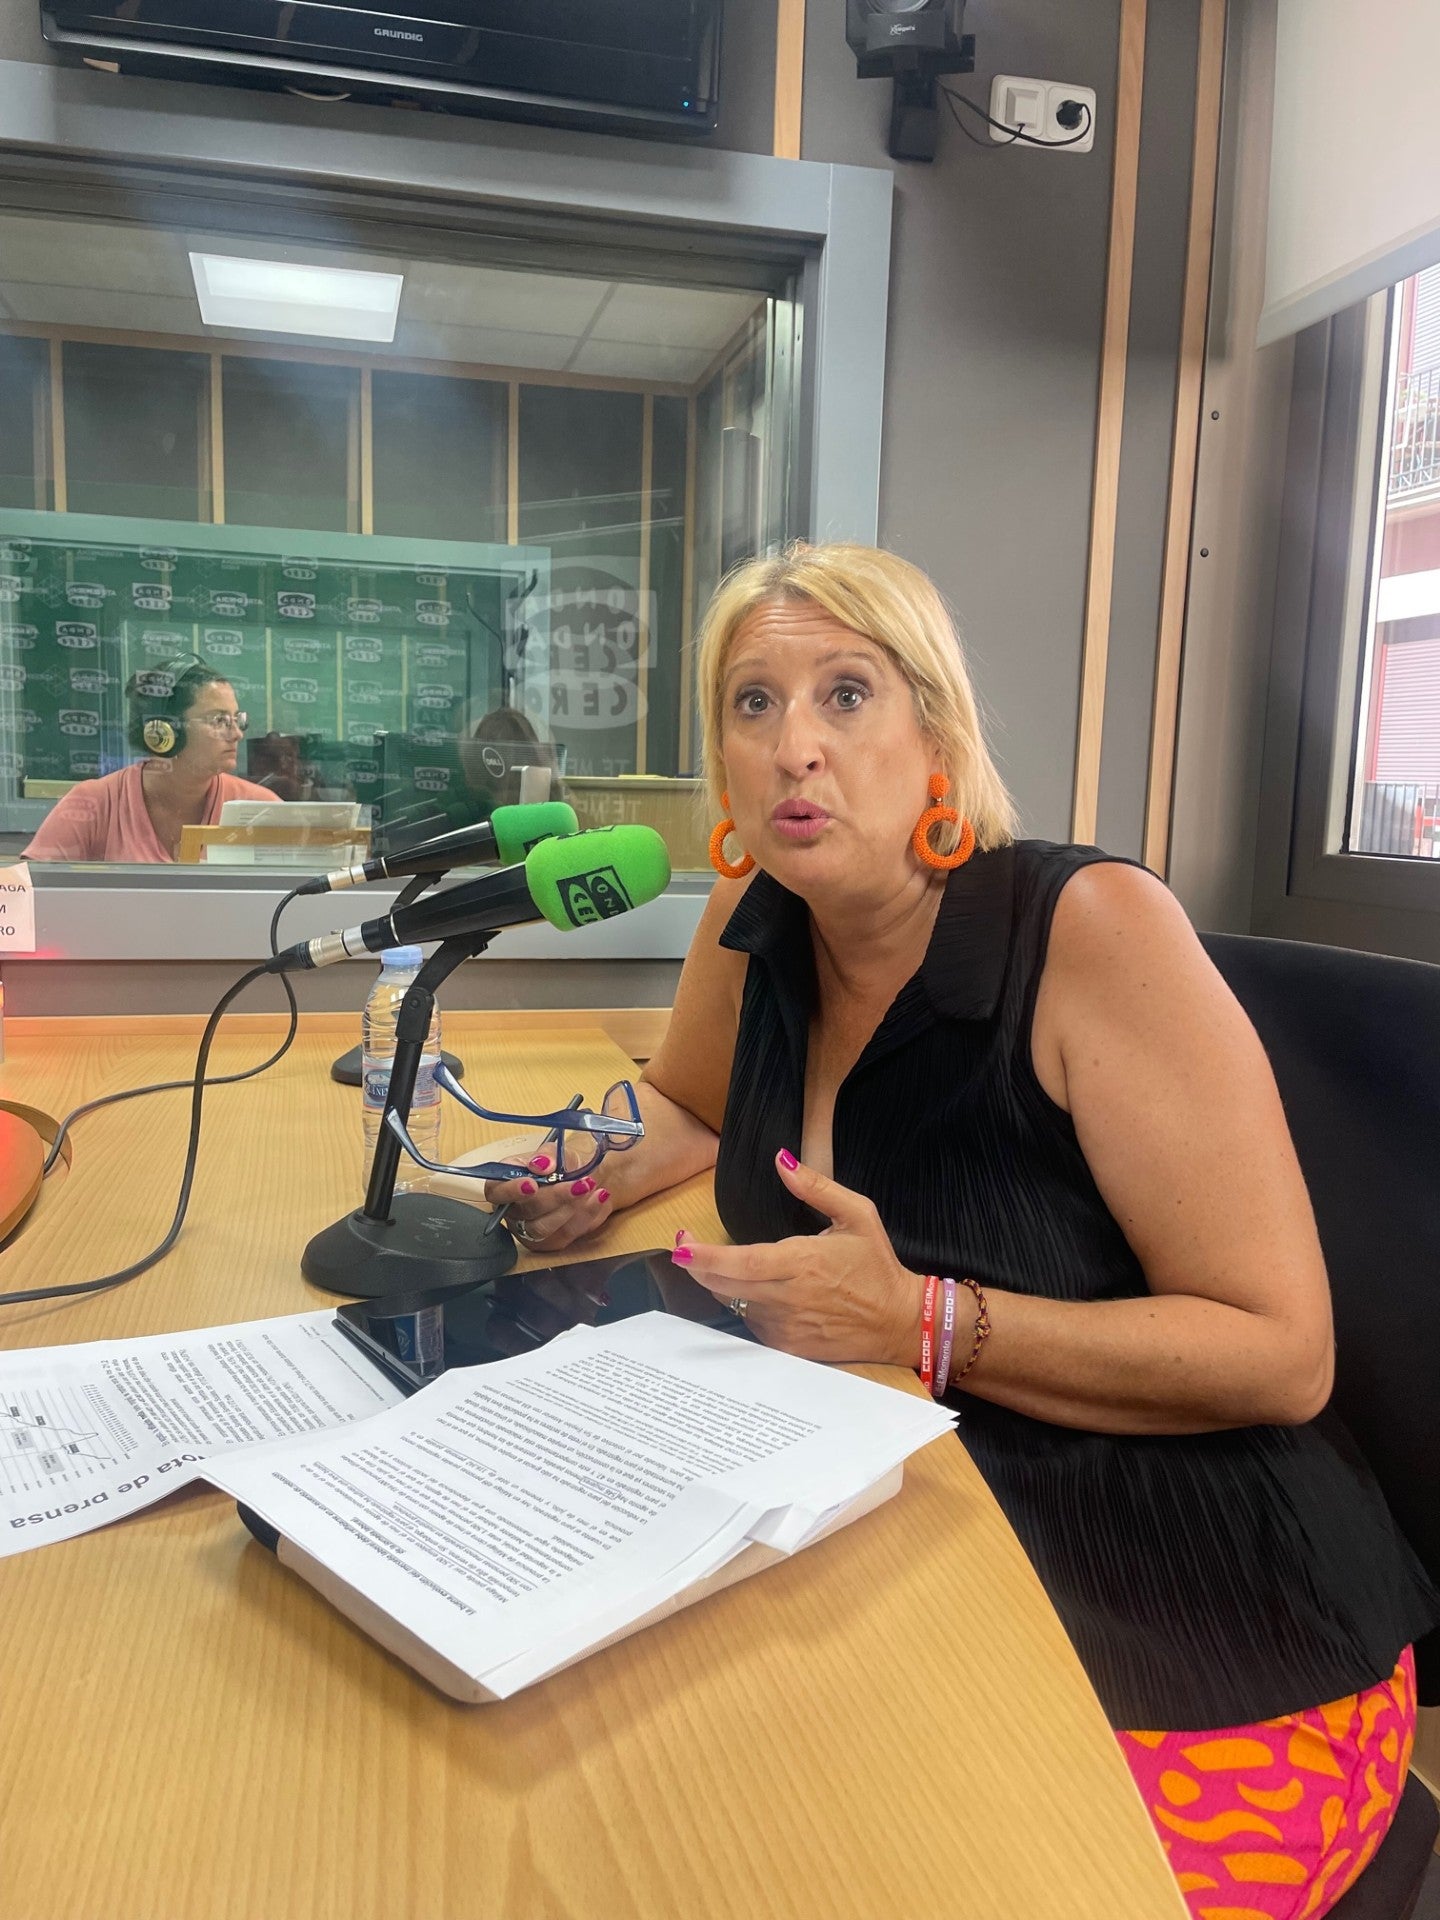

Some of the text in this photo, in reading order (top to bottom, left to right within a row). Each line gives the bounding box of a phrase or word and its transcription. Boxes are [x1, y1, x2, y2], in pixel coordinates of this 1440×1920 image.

[374, 28, 424, 42] GRUNDIG
[157, 1454, 206, 1474] ota
[117, 1474, 151, 1494] de
[10, 1492, 110, 1529] prensa
